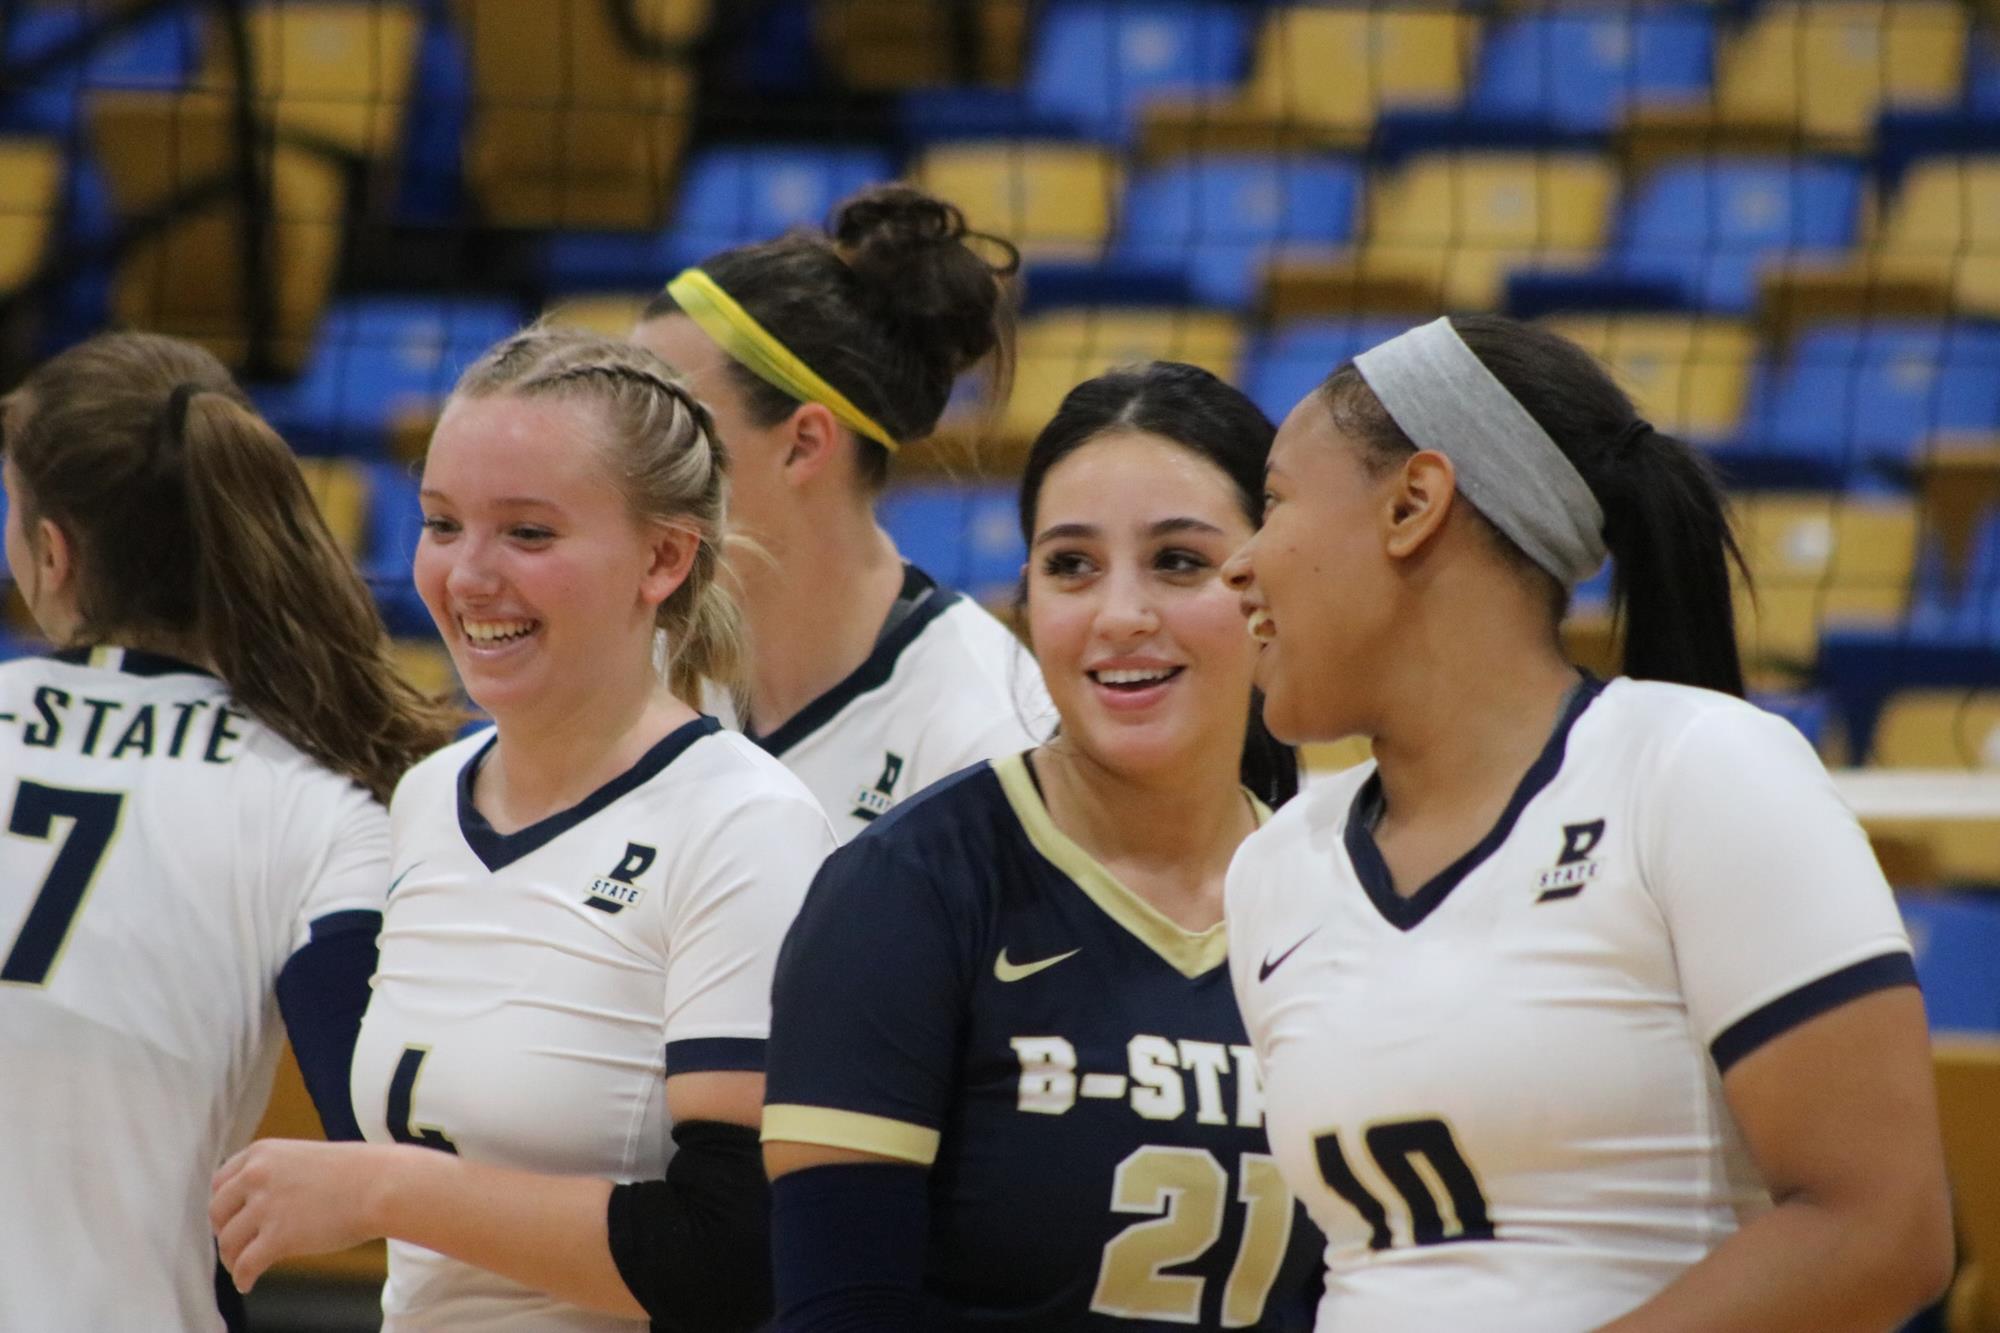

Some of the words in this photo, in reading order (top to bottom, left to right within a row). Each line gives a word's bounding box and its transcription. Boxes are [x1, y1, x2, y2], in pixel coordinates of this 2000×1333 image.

[0, 777, 127, 988] 7
[591, 879, 639, 903] STATE
[1539, 862, 1598, 887] STATE
[1089, 1144, 1295, 1329] 21
[1309, 1114, 1495, 1253] 10
